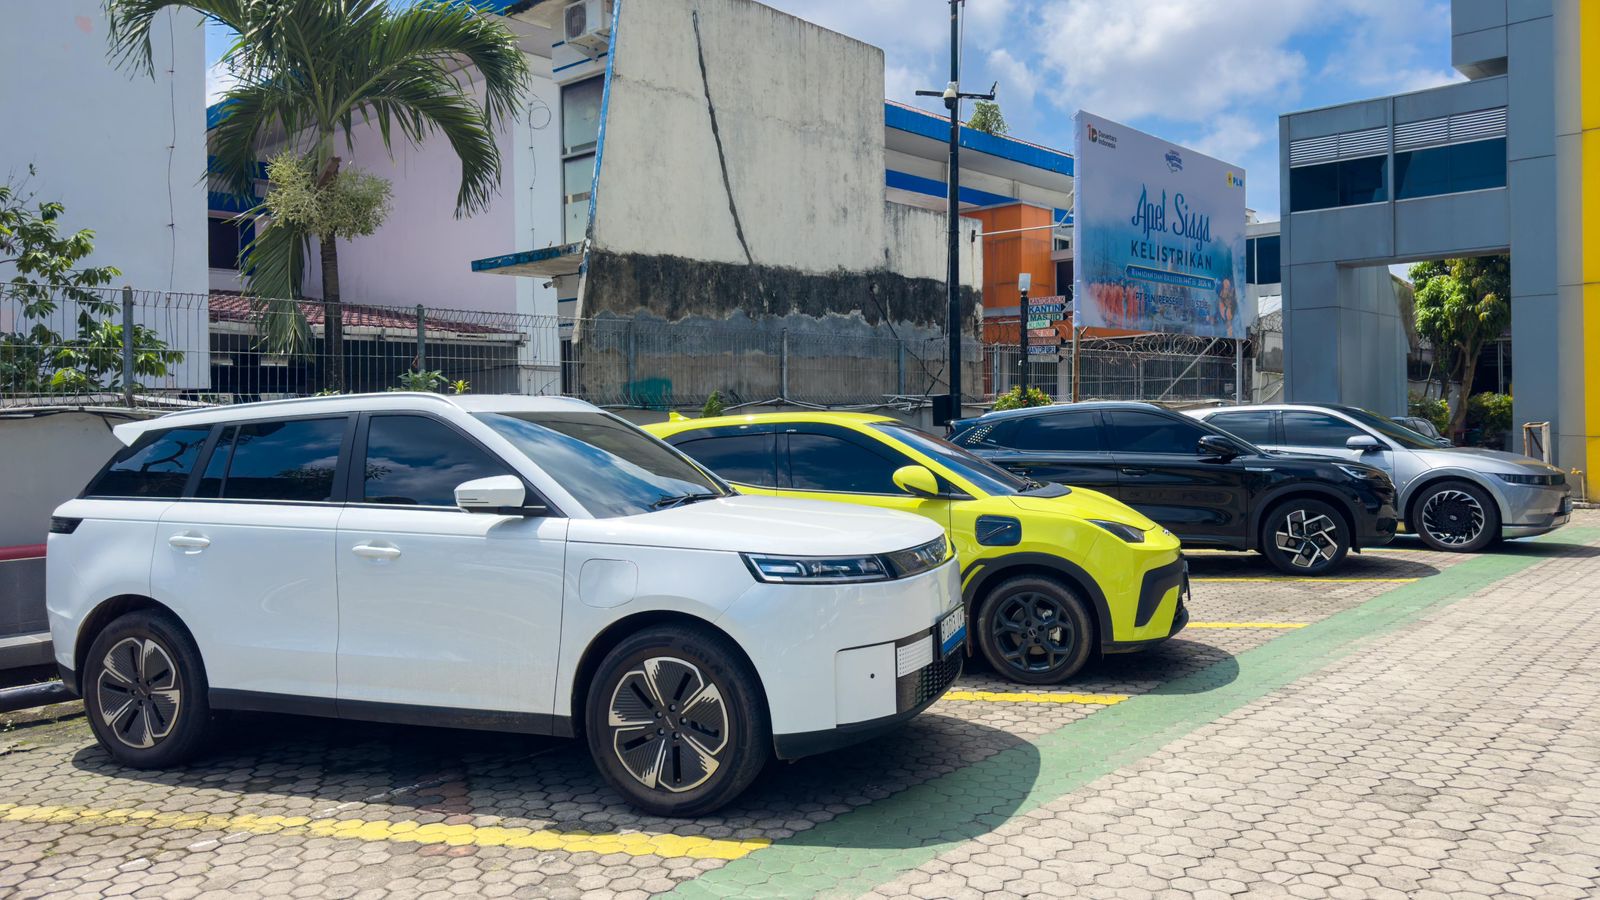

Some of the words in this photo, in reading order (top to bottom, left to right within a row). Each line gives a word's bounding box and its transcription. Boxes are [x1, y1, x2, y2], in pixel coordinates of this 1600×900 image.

[1232, 176, 1243, 187] PLN
[1131, 183, 1168, 241] Apel
[1172, 193, 1212, 252] Siaga
[1131, 240, 1213, 271] KELISTRIKAN
[1136, 292, 1144, 301] PT
[1029, 304, 1061, 313] KANTIN
[1030, 313, 1061, 321] MASJID
